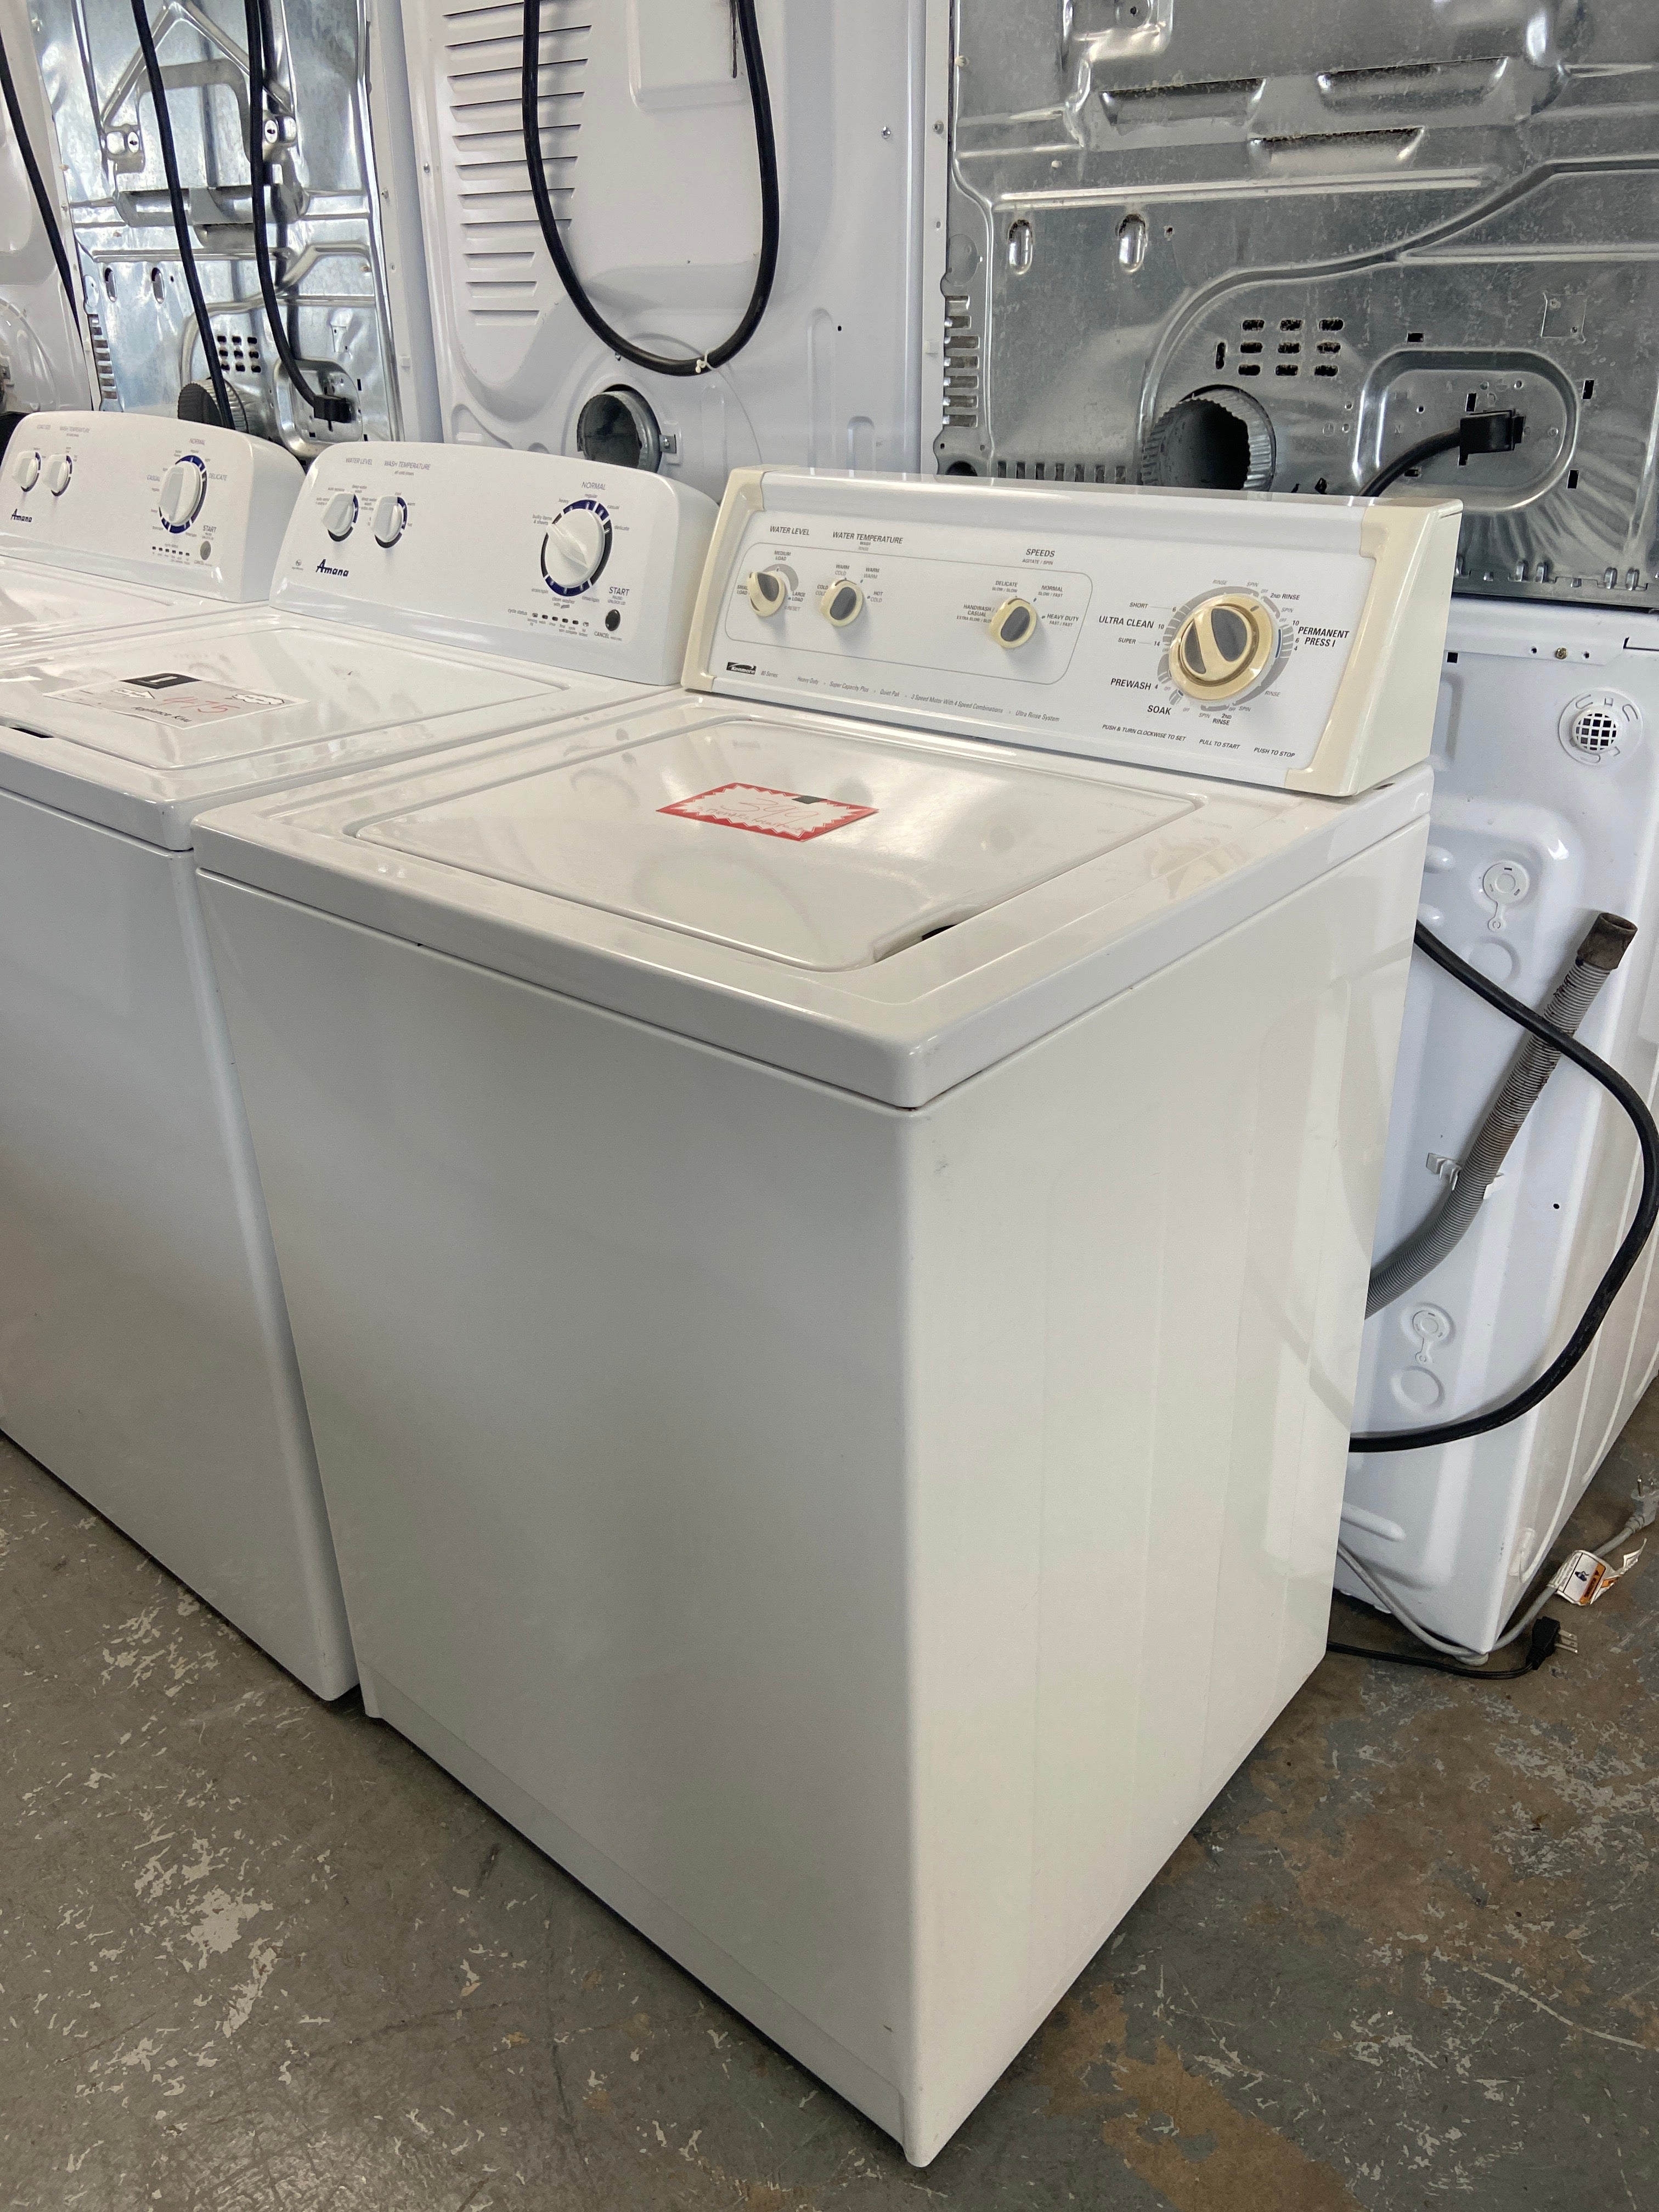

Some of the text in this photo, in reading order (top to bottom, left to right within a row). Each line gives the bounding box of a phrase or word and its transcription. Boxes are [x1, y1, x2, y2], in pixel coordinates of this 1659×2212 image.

[398, 461, 431, 470] TEMPERATURE
[582, 482, 606, 490] NORMAL
[10, 509, 32, 522] Amana
[770, 526, 790, 534] WATER
[833, 532, 903, 544] WATER TEMPERATURE
[1026, 549, 1055, 557] SPEEDS
[315, 559, 349, 577] Amana
[609, 586, 630, 596] START
[1099, 615, 1154, 629] ULTRA CLEAN
[1298, 627, 1350, 639] PERMANENT
[1304, 637, 1330, 647] PRESS
[731, 666, 756, 674] Kenmore
[1110, 678, 1152, 690] PREWASH
[797, 676, 809, 684] Heavy
[842, 683, 859, 691] Capacity
[973, 703, 1003, 713] Combinations
[1042, 714, 1060, 722] System
[1147, 705, 1172, 715] SOAK
[1137, 729, 1166, 738] CLOCKWISE
[720, 798, 820, 824] 399
